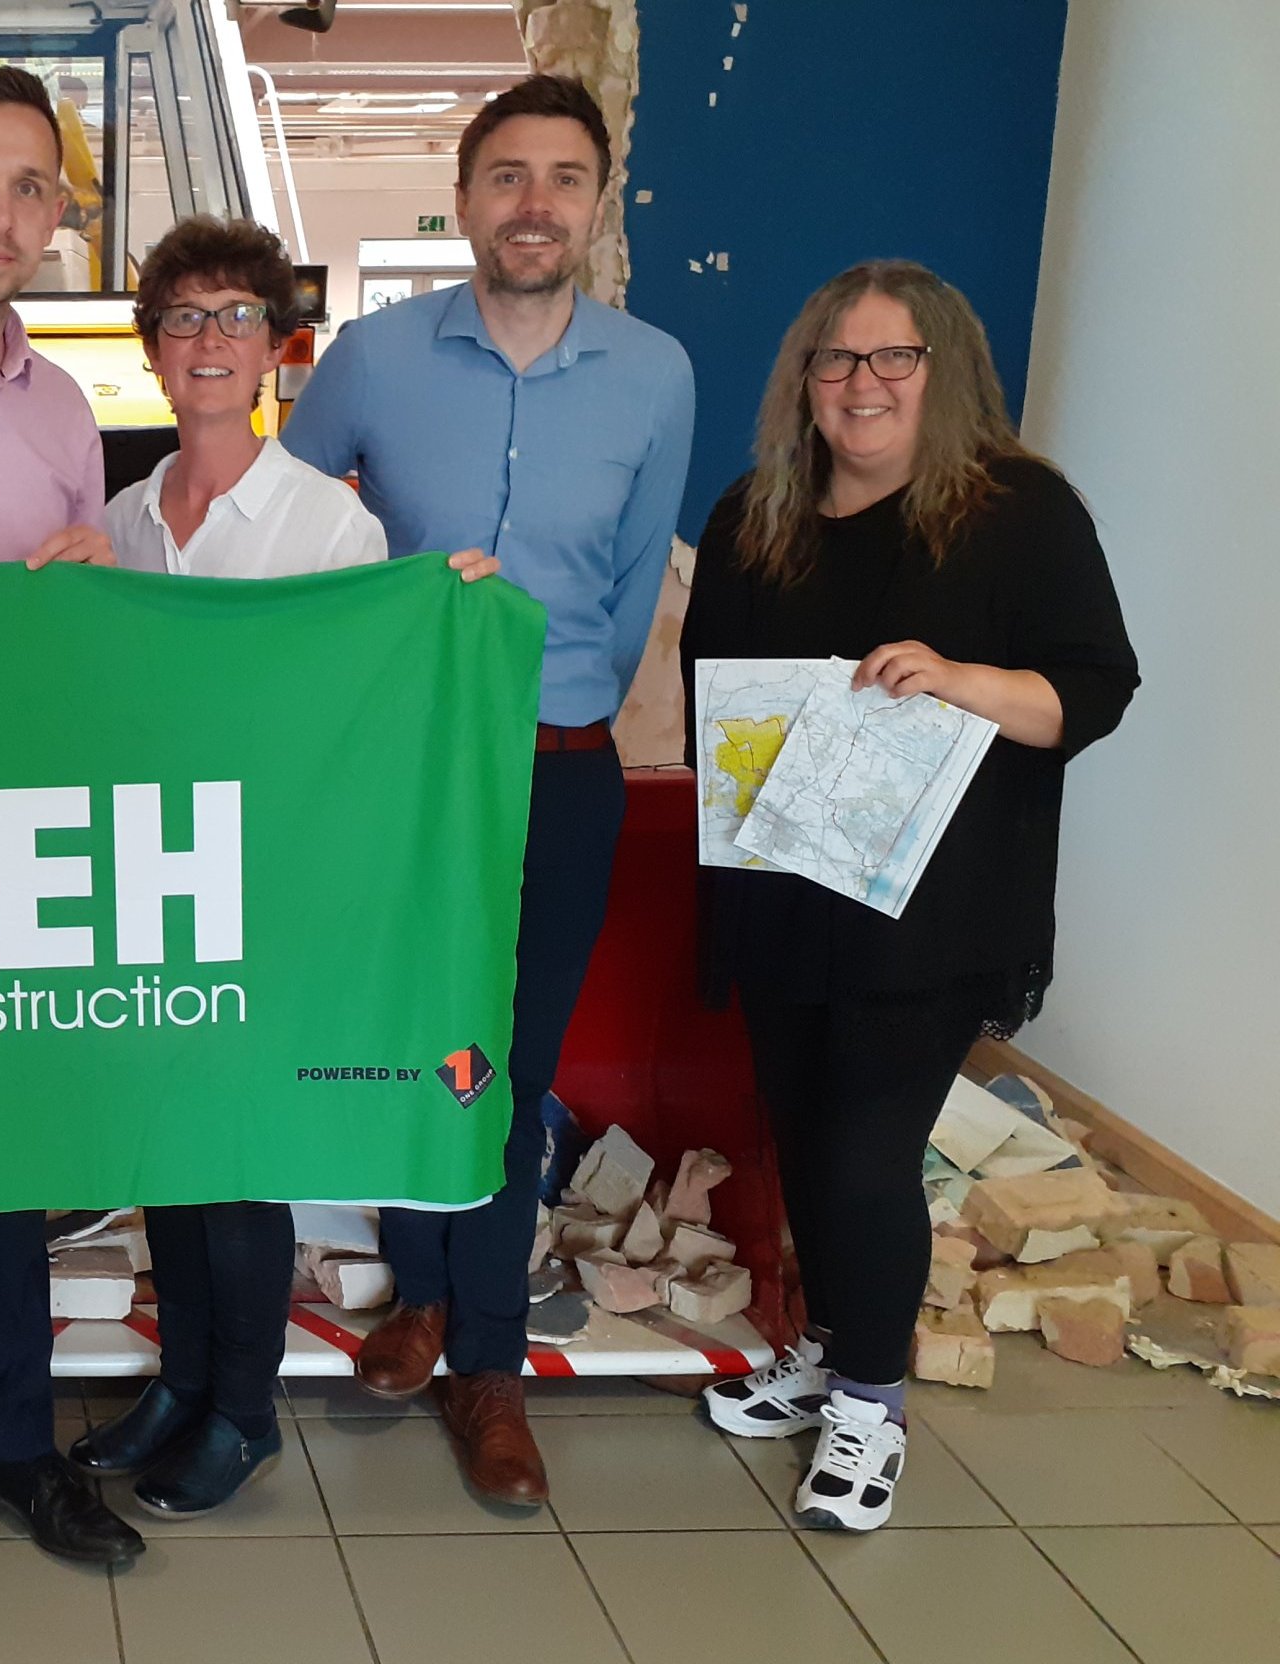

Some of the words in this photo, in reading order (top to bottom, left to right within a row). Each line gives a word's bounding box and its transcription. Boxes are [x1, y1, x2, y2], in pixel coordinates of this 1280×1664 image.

[297, 1067, 390, 1081] POWERED
[396, 1068, 421, 1081] BY
[444, 1049, 471, 1090] 1
[459, 1090, 475, 1103] ONE
[474, 1068, 493, 1091] GROUP
